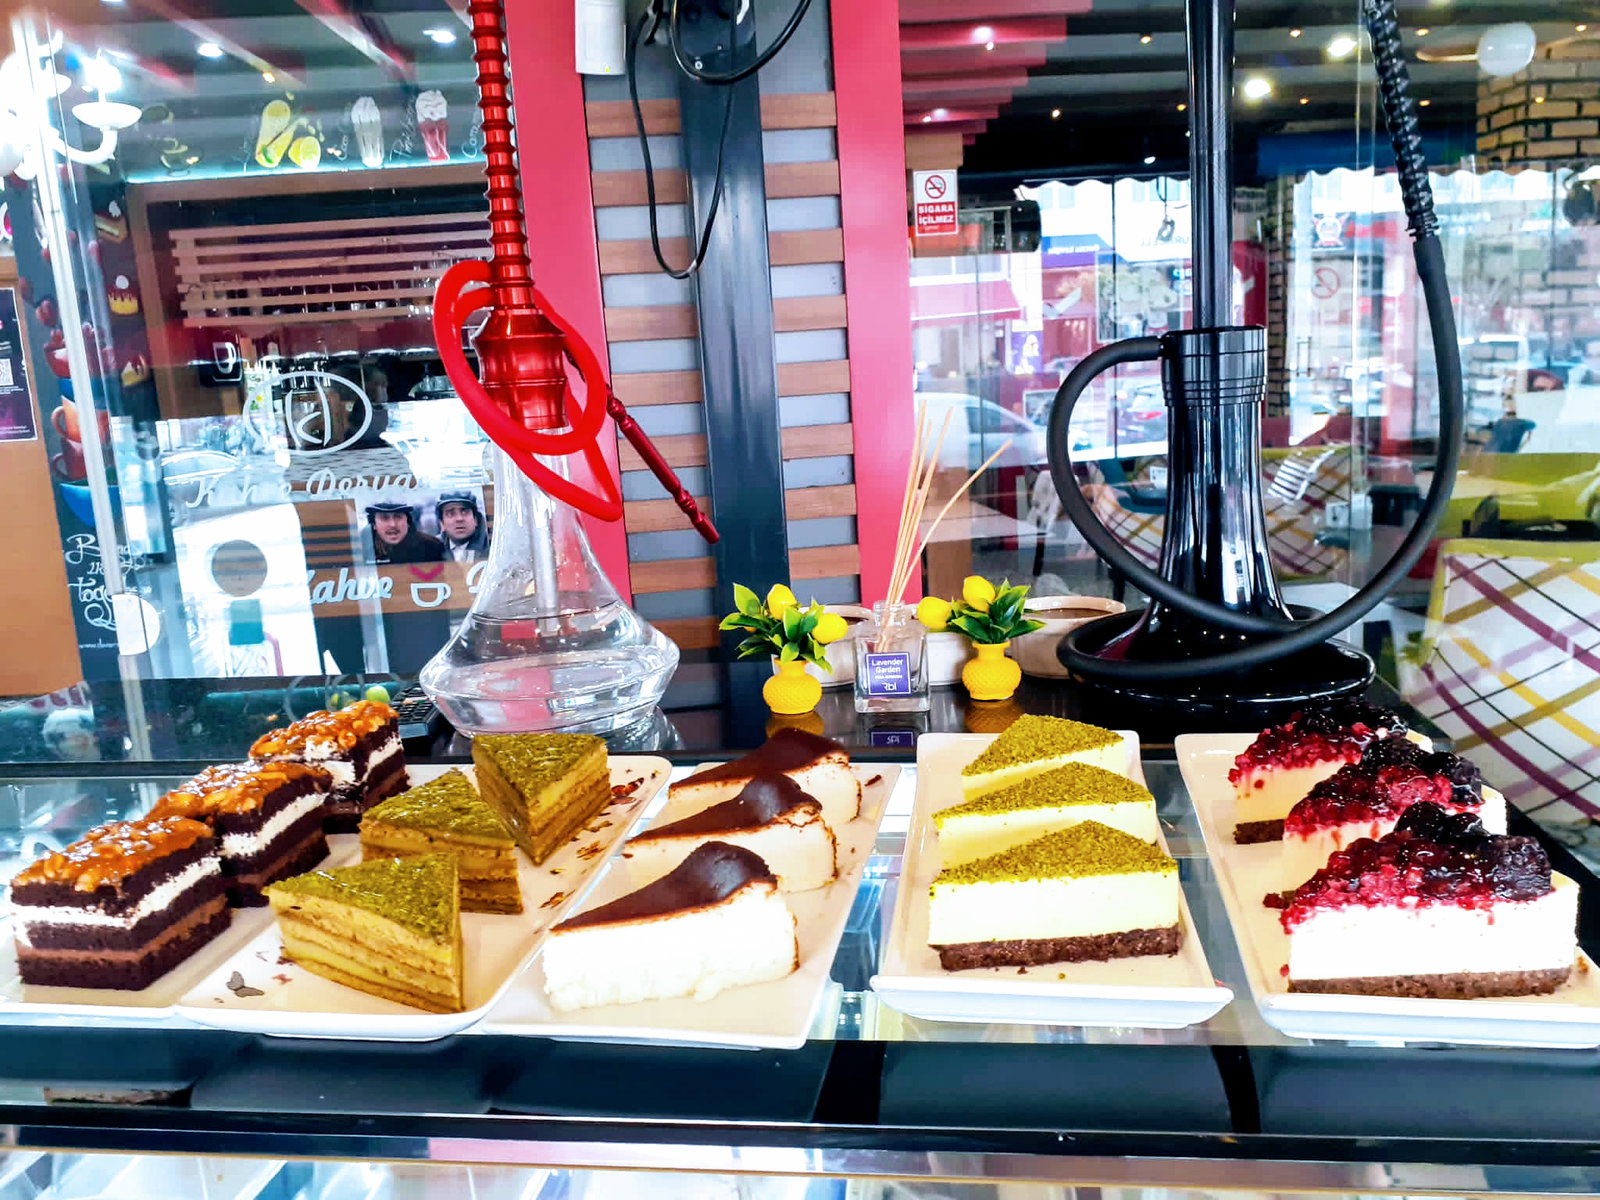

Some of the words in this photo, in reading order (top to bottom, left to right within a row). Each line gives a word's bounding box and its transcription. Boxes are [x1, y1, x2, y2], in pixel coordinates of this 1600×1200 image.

[308, 567, 394, 605] ahve
[872, 658, 904, 667] Lavender
[875, 666, 901, 674] Garden
